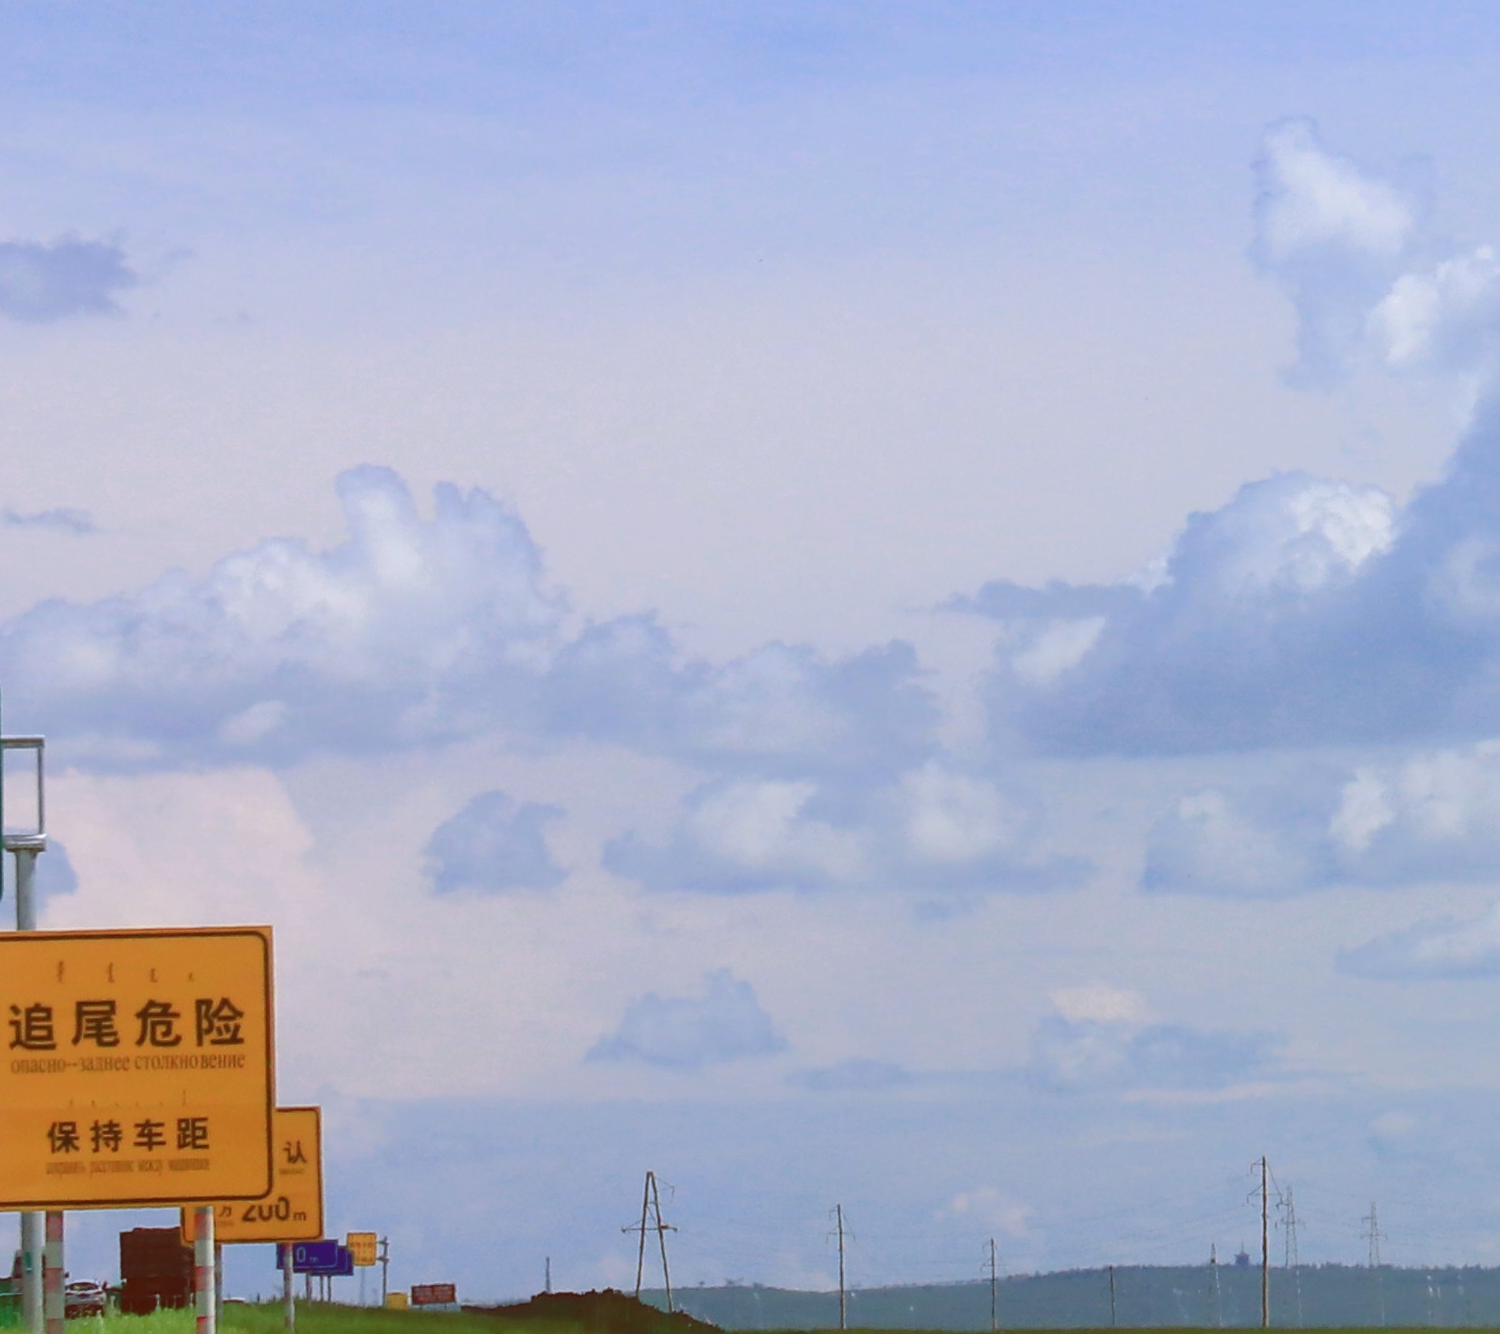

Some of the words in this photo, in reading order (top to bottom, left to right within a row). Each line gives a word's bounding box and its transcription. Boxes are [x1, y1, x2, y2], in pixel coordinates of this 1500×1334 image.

[8, 997, 245, 1050] 追尾危险
[47, 1117, 210, 1154] 保持车距
